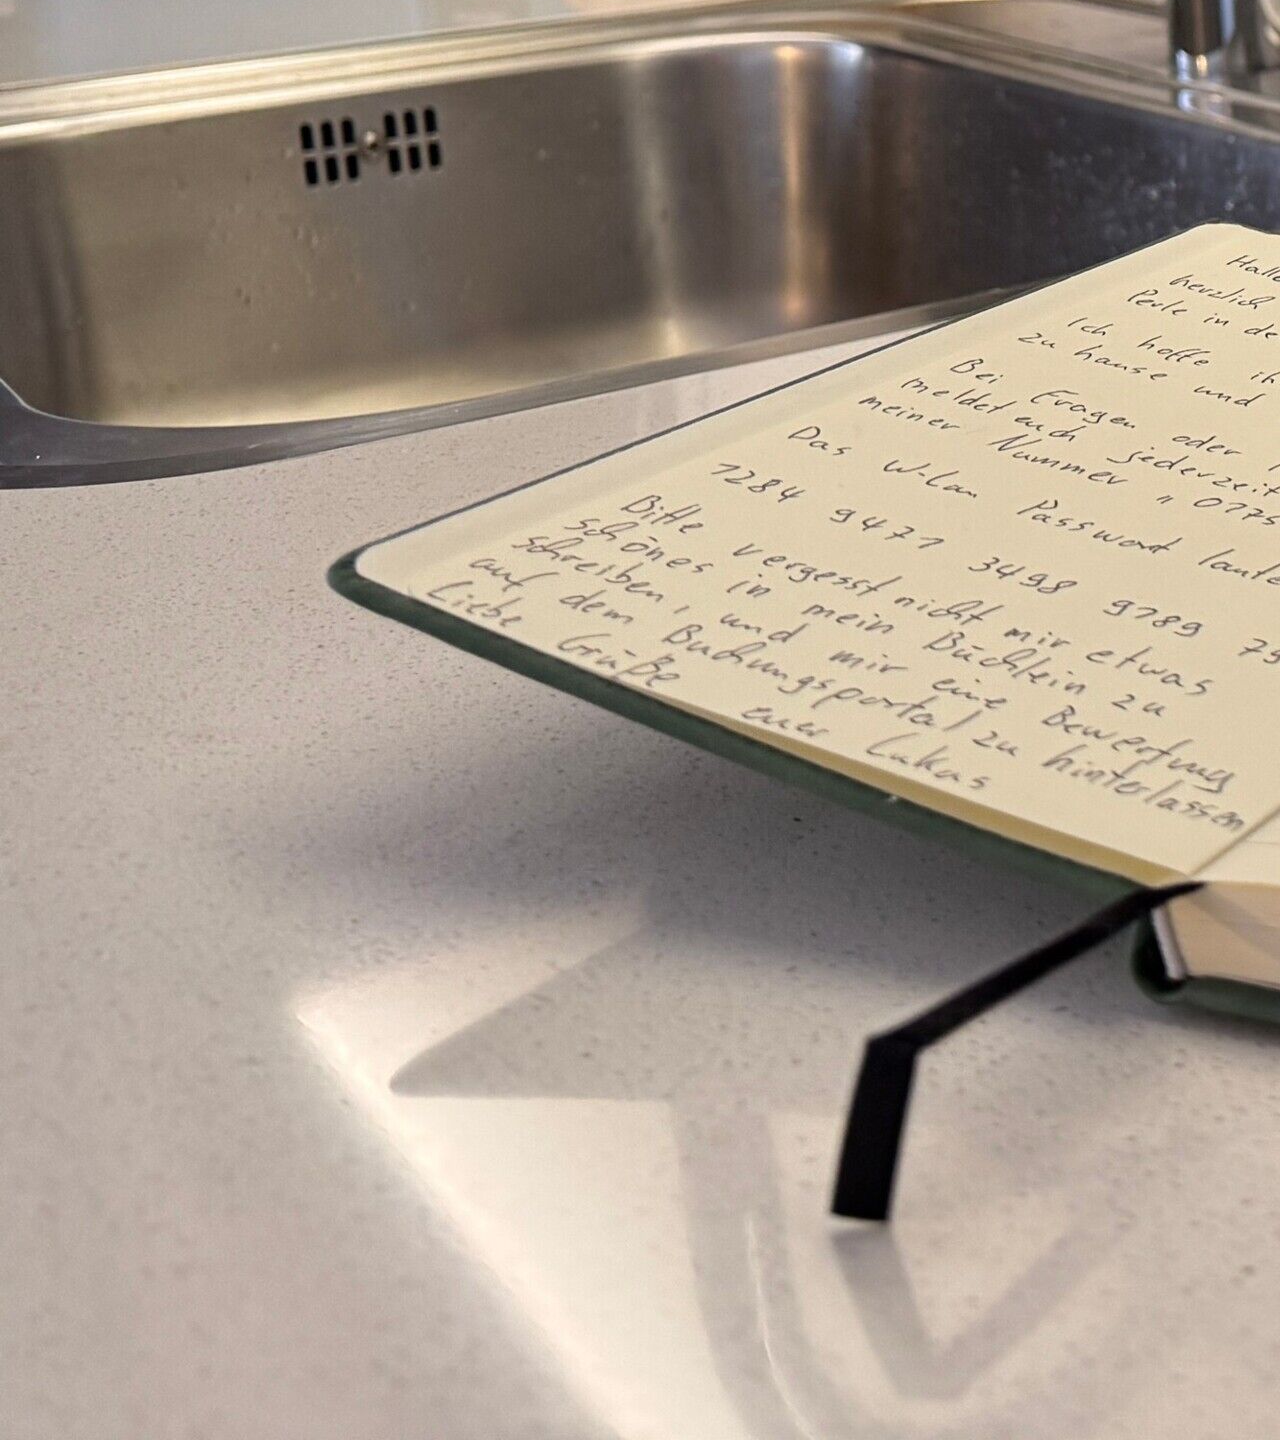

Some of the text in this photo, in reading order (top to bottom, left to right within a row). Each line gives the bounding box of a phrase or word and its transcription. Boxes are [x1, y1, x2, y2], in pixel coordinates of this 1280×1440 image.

[1127, 289, 1188, 316] Perle
[1203, 313, 1230, 327] in
[1169, 274, 1276, 310] herzlich
[1067, 317, 1114, 336] Ich
[1137, 335, 1212, 367] hoffe
[858, 395, 961, 431] meiner
[988, 434, 1129, 486] Nummer
[901, 377, 1017, 414] meldet
[1014, 415, 1087, 443] euch
[950, 357, 1004, 384] Bei
[1030, 389, 1136, 429] Fragen
[1172, 435, 1243, 456] oder
[1193, 385, 1267, 408] und
[788, 425, 853, 456] Das
[1016, 499, 1183, 555] Passwort
[620, 494, 1218, 696] Bitte vergesst nicht mir etwas
[967, 556, 1078, 595] 3498
[727, 573, 773, 599] in
[802, 602, 896, 637] mein
[922, 630, 1089, 697] Büchlein
[426, 580, 524, 628] Liebe
[557, 632, 682, 687] Grüße
[866, 732, 993, 791] Lukas
[469, 557, 561, 591] auf
[559, 589, 635, 625] dem
[662, 623, 983, 732] Buchungsportal
[1041, 743, 1248, 830] hinterlassen
[719, 612, 811, 645] und
[828, 647, 910, 676] mir
[931, 675, 1009, 711] eine
[1041, 704, 1237, 794] Bewertung
